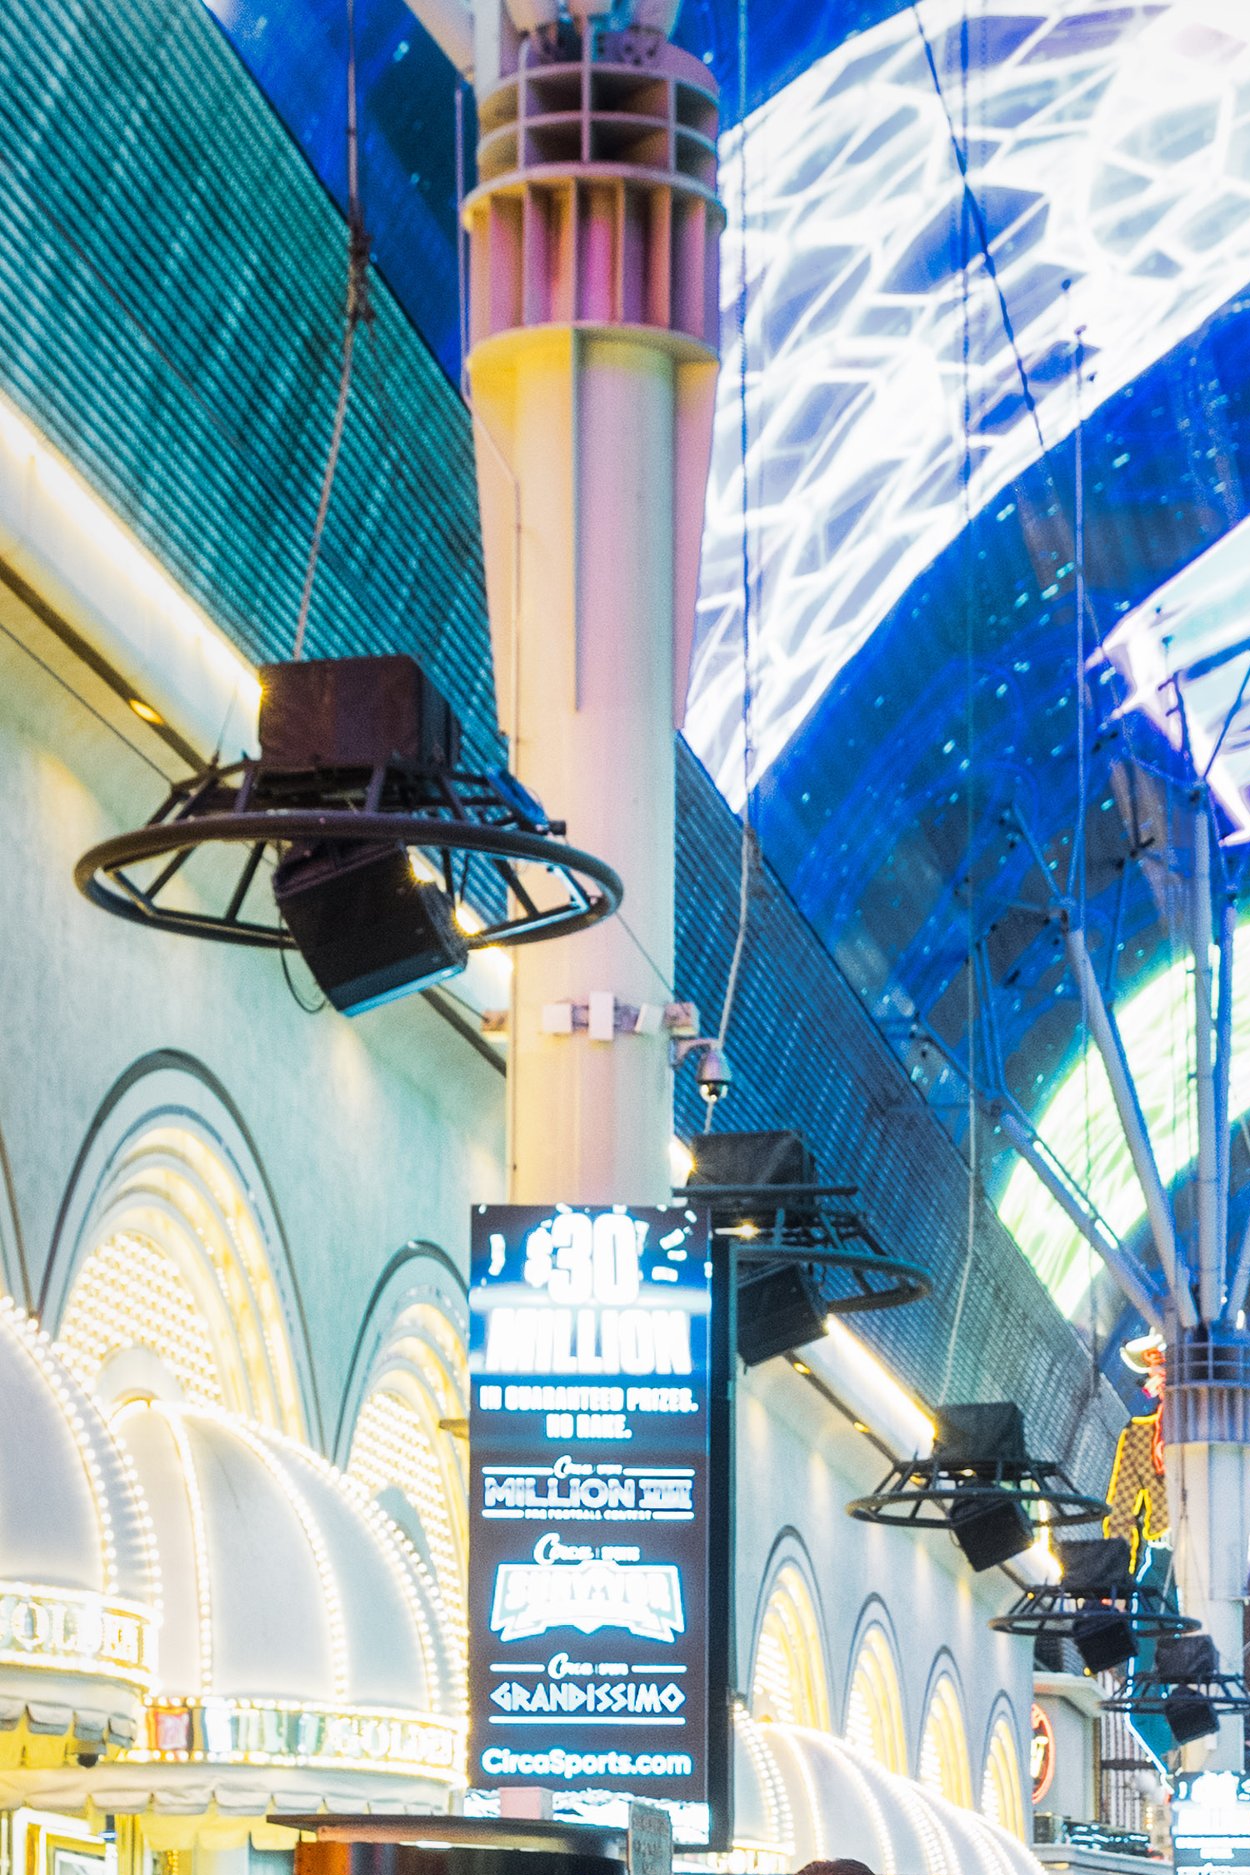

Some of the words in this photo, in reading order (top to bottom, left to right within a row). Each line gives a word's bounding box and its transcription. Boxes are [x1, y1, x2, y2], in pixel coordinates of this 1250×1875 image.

[486, 1308, 693, 1375] MILLION
[484, 1477, 636, 1508] MILLION
[489, 1681, 687, 1713] GRANDISSIMO
[481, 1747, 692, 1780] CircaSports.com
